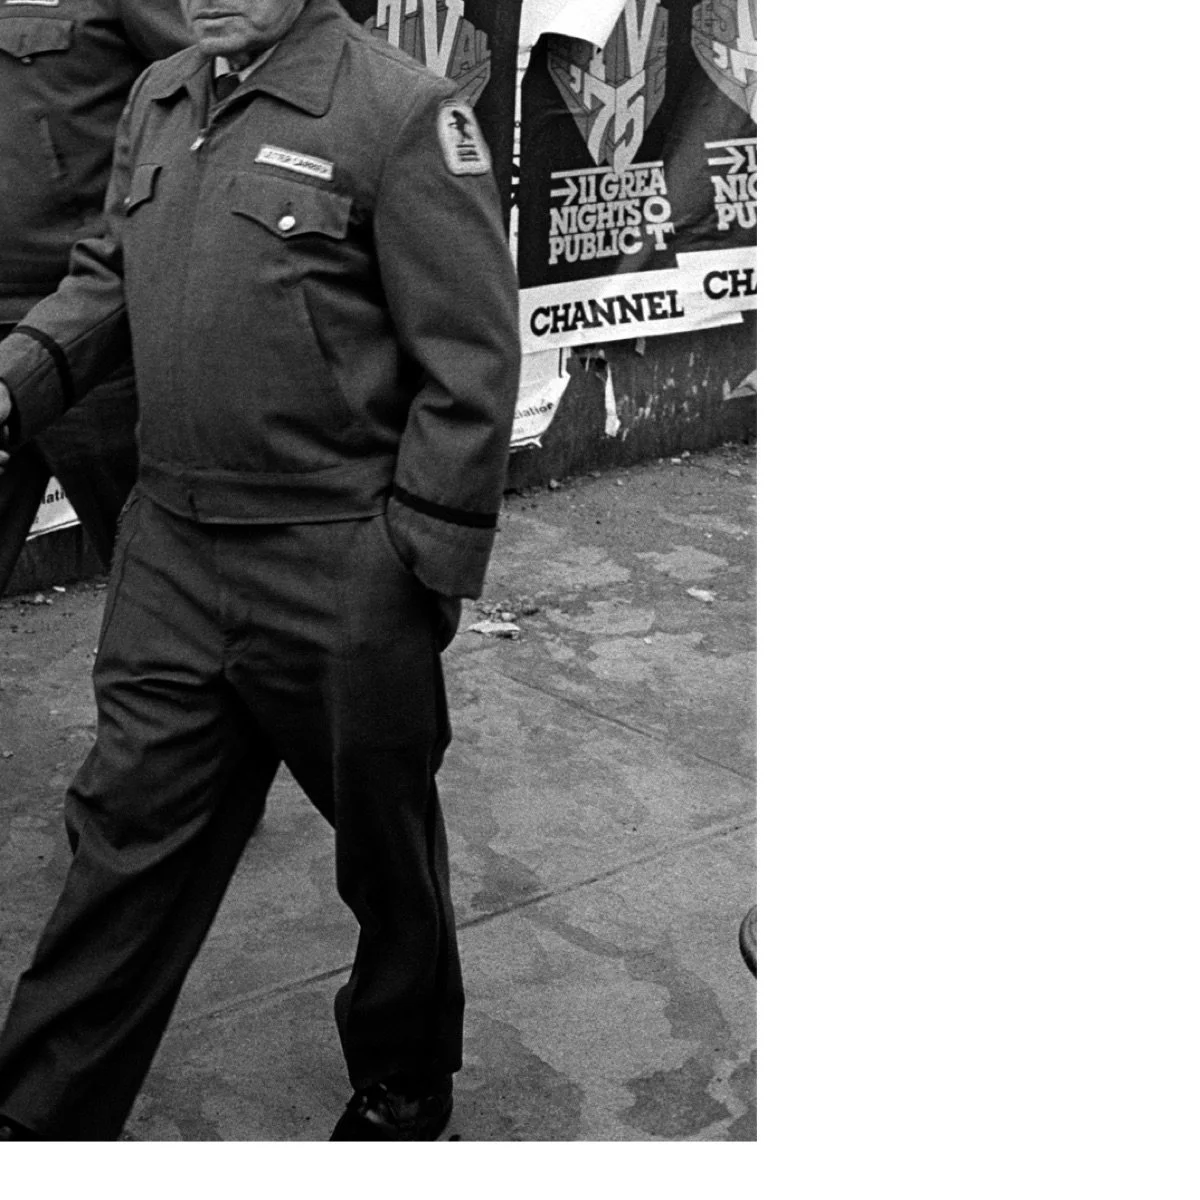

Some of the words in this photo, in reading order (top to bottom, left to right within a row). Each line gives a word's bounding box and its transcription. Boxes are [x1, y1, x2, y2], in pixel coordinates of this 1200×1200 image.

[600, 168, 667, 200] GREA
[550, 199, 642, 236] NIGHTS
[549, 226, 643, 265] PUBLIC
[530, 289, 685, 337] CHANNEL
